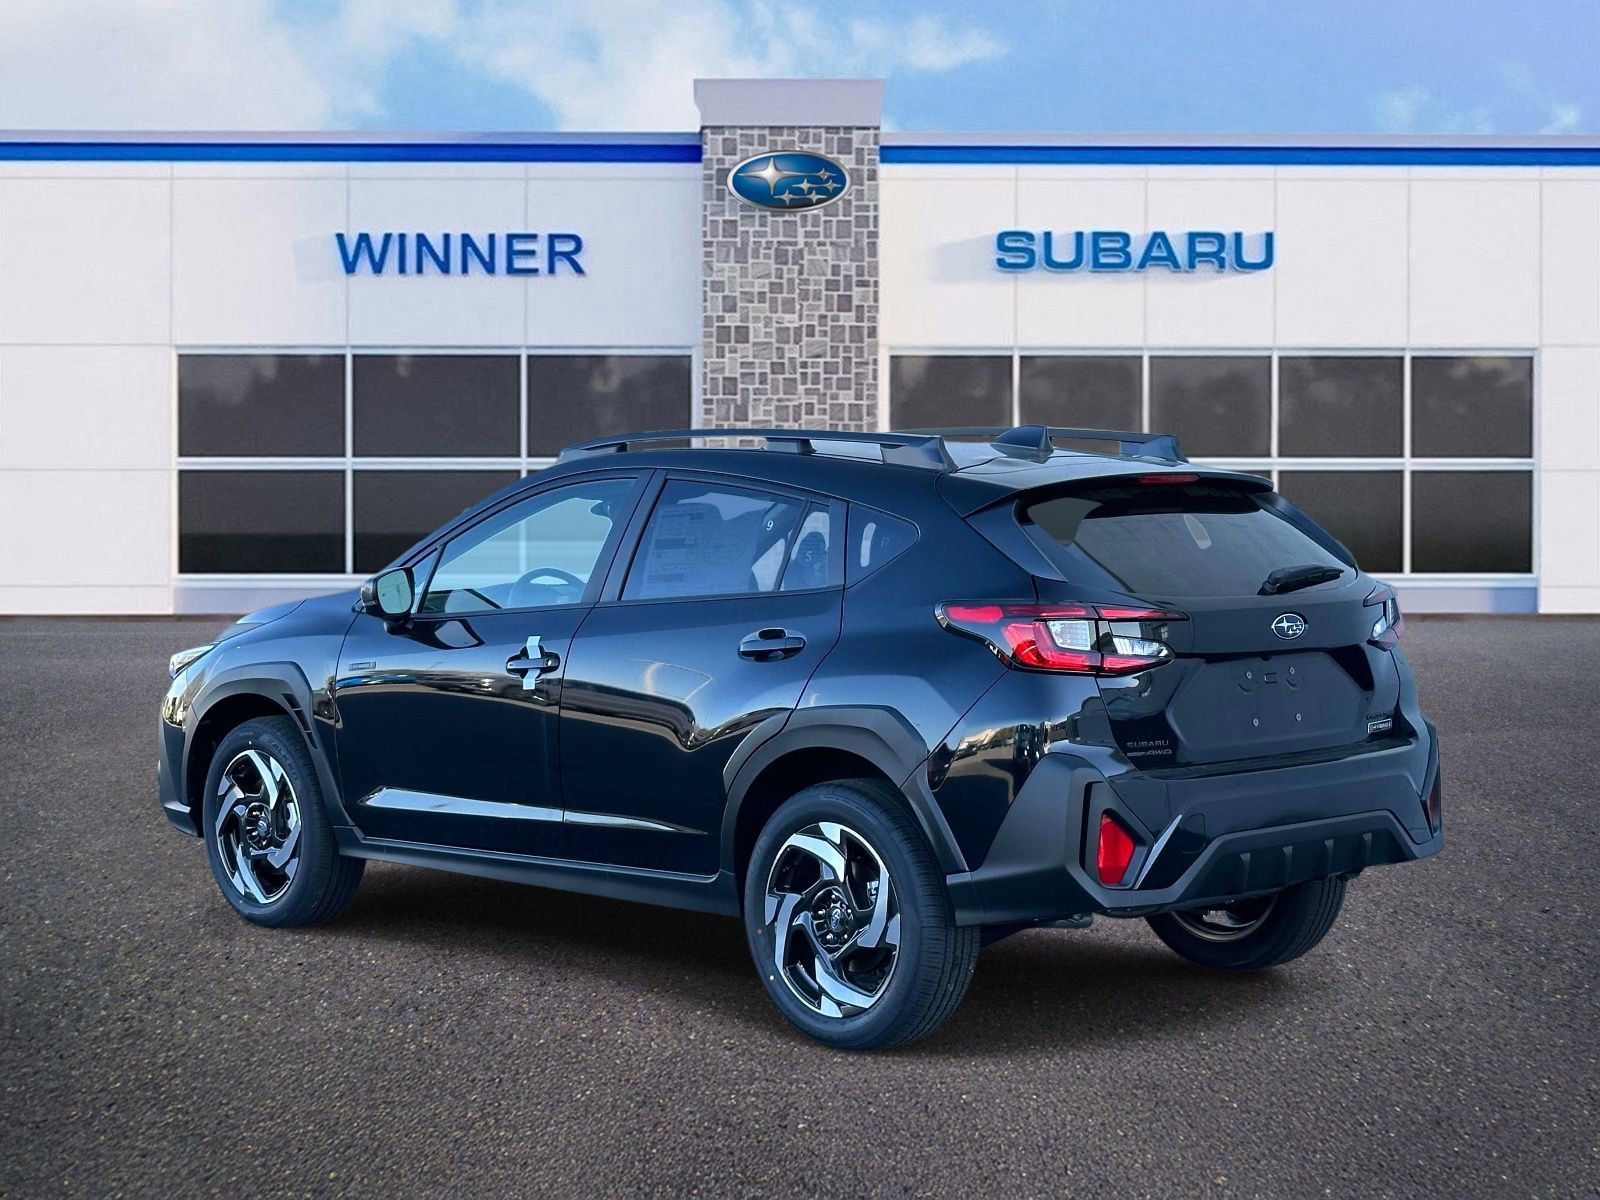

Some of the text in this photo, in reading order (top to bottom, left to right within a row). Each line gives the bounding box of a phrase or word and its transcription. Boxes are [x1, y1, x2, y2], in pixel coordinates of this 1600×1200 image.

[335, 232, 586, 276] WINNER
[995, 230, 1275, 273] SUBARU
[1126, 739, 1169, 748] SUBARU
[1144, 748, 1173, 756] AWD
